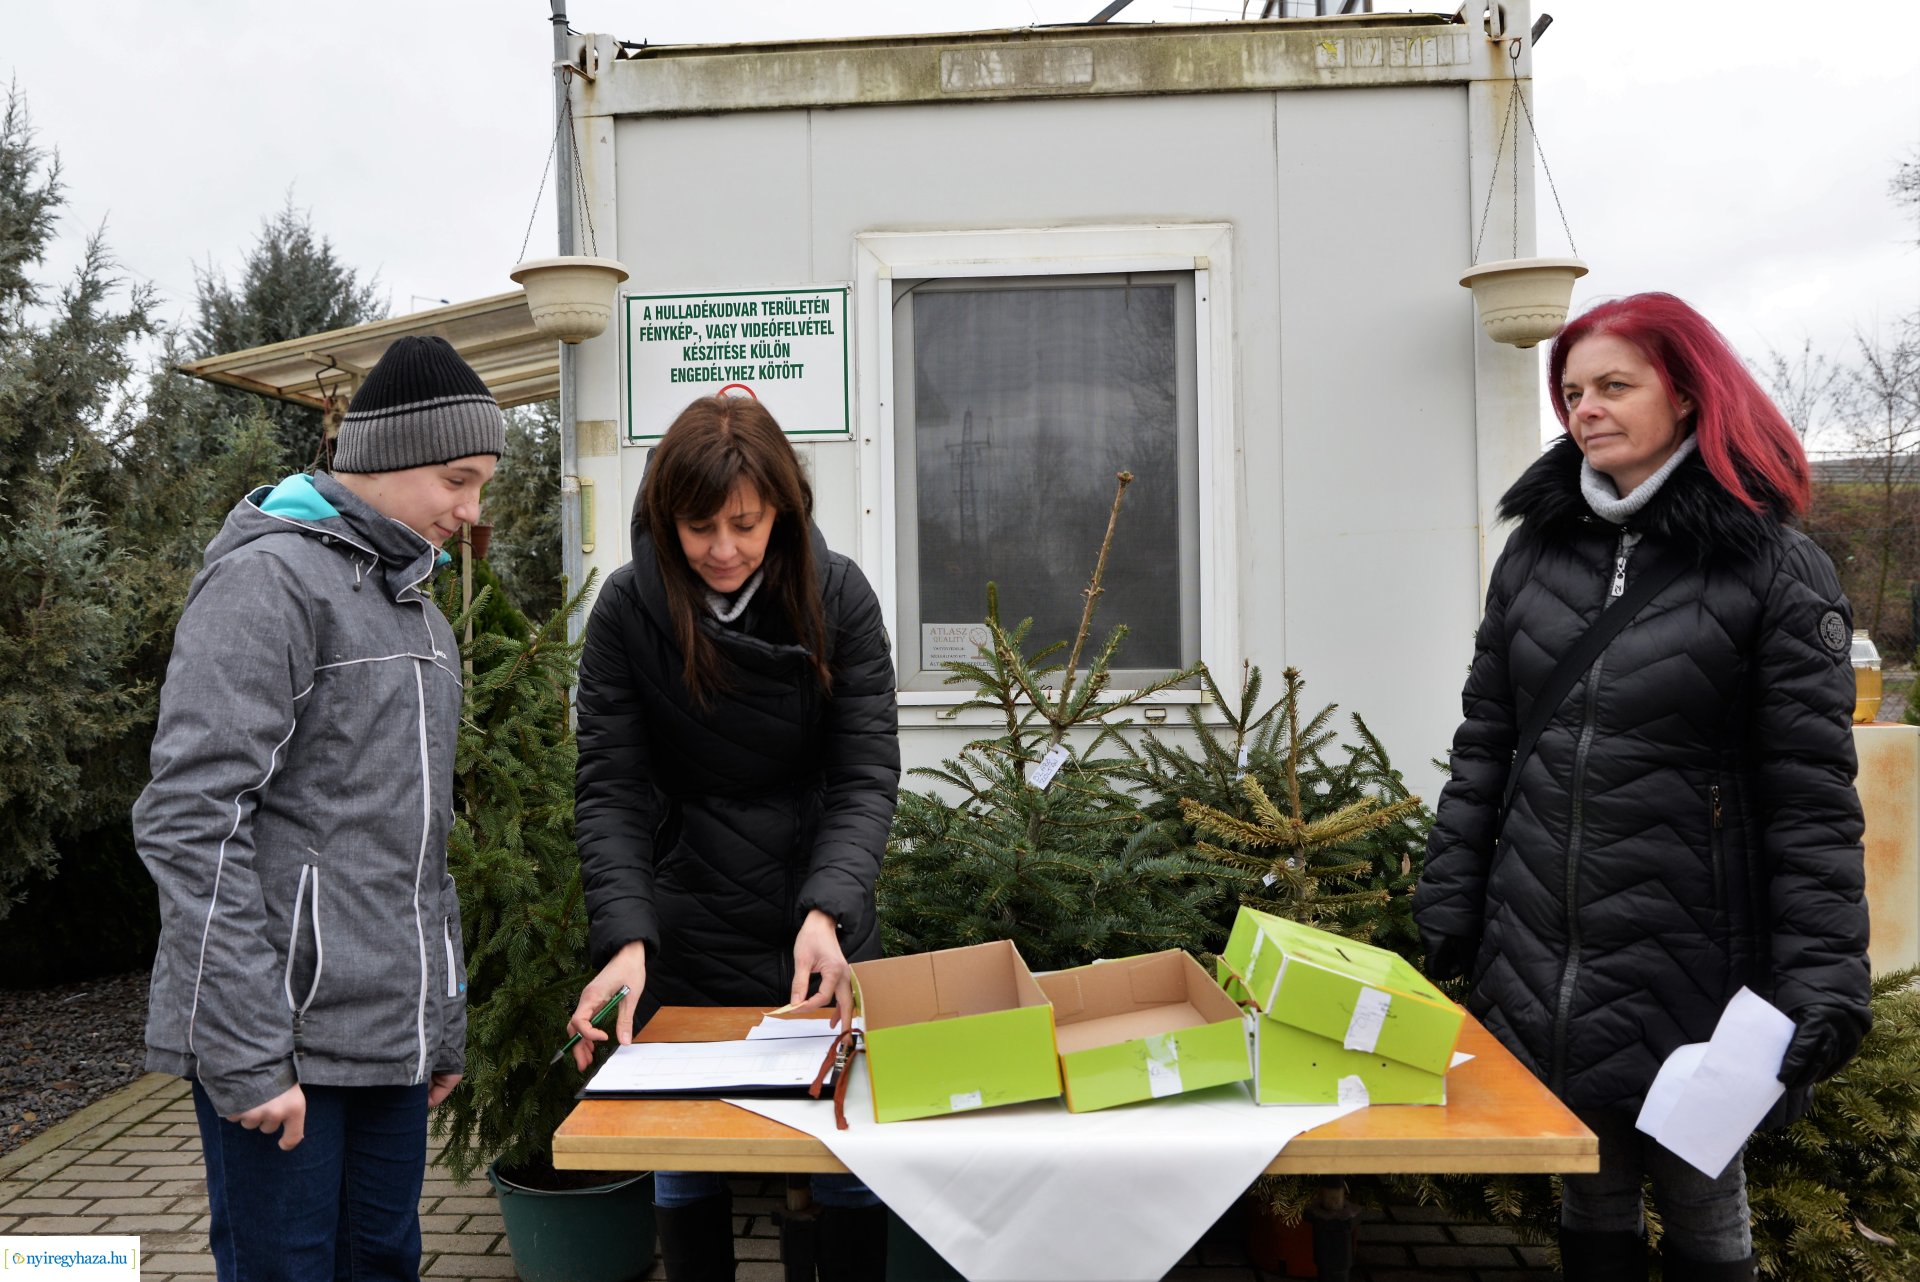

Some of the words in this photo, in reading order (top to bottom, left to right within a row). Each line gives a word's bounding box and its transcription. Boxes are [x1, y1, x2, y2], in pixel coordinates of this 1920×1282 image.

[643, 306, 652, 321] A
[655, 300, 758, 320] HULLADÉKUDVAR
[761, 296, 830, 317] TERÜLETÉN
[639, 322, 702, 342] FÉNYKÉP-,
[705, 323, 737, 340] VAGY
[741, 317, 835, 338] VIDEÓFELVÉTEL
[683, 341, 747, 362] KÉSZÍTÉSE
[750, 339, 791, 360] KÜLÖN
[670, 362, 755, 383] ENGEDÉLYHEZ
[758, 360, 804, 381] KÖTÖTT
[930, 627, 967, 635] ATLASZ
